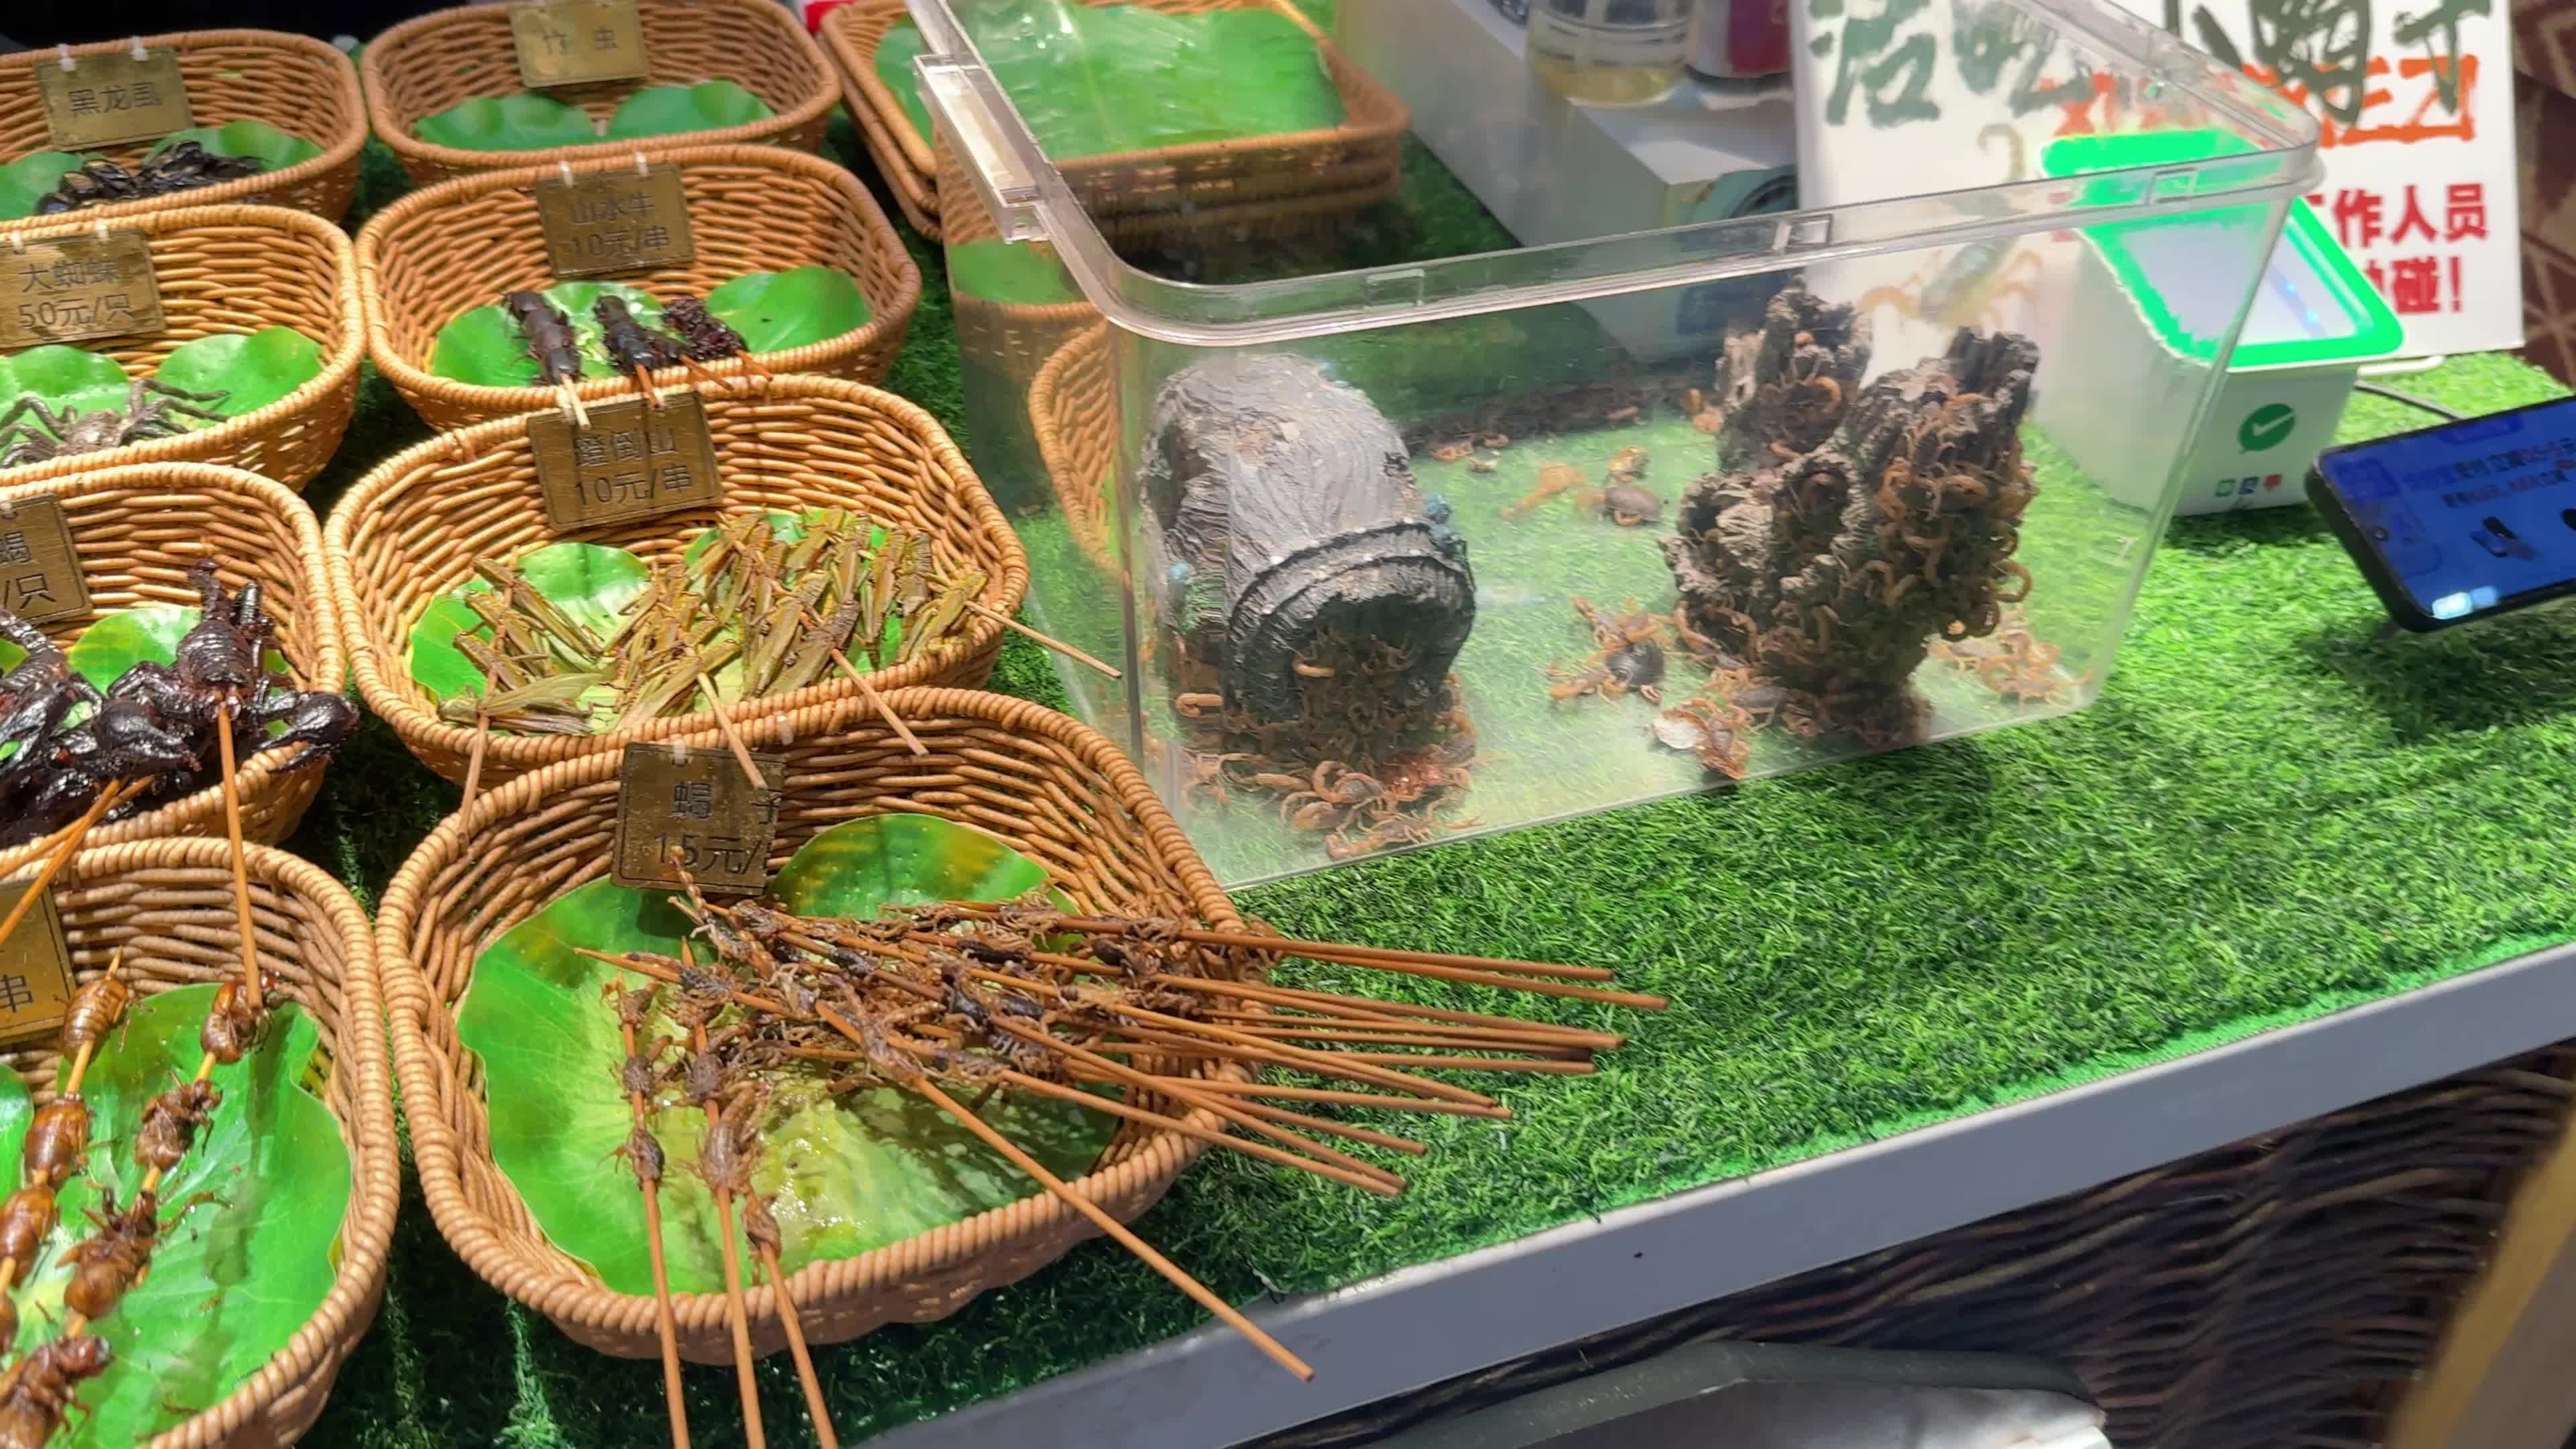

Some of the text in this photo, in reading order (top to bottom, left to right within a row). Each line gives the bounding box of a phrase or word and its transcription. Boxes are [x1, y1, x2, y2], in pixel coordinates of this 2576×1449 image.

[2306, 182, 2490, 248] 作人员
[19, 254, 119, 292] 大蜘蛛
[19, 293, 135, 327] 50元/只
[574, 464, 694, 504] 10元/串
